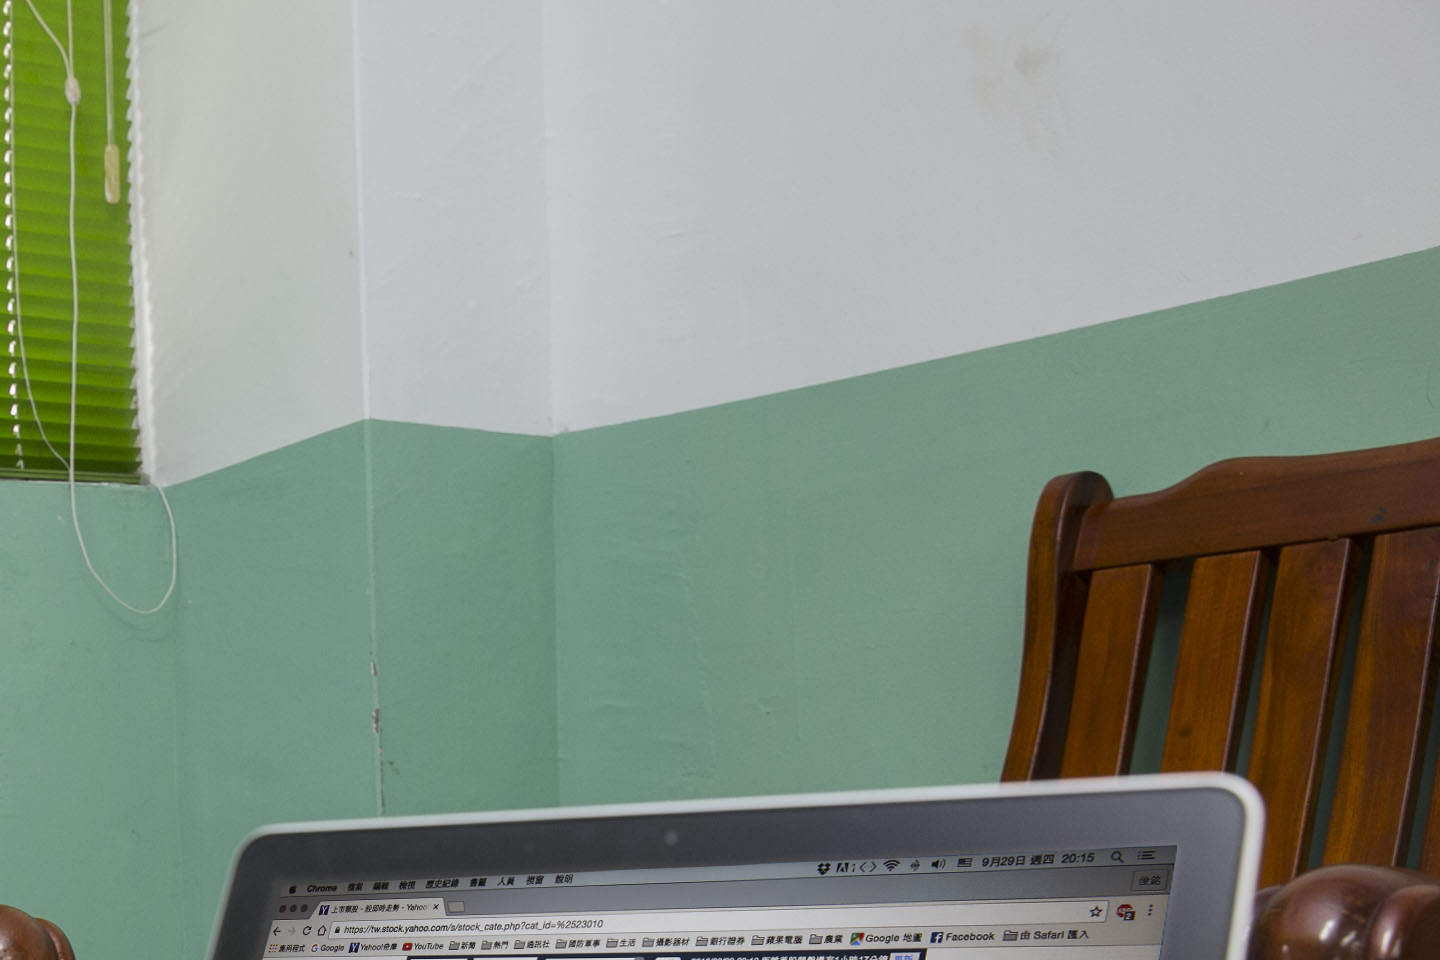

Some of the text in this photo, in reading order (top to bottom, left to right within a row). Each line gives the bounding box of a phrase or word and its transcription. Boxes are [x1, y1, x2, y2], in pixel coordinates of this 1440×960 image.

[981, 852, 1096, 868] 9月29日 週四 20:15
[307, 884, 338, 893] Chrome
[497, 876, 515, 886] 人員
[344, 919, 604, 935] https://tw.stock.yahoo.com/s/stock_cate.php?cat_id=%2523010
[865, 934, 900, 943] Google
[946, 931, 995, 941] Facebook
[1033, 930, 1065, 940] Safari
[413, 942, 444, 951] YouTube
[619, 938, 636, 947] 生活
[321, 944, 345, 952] Google
